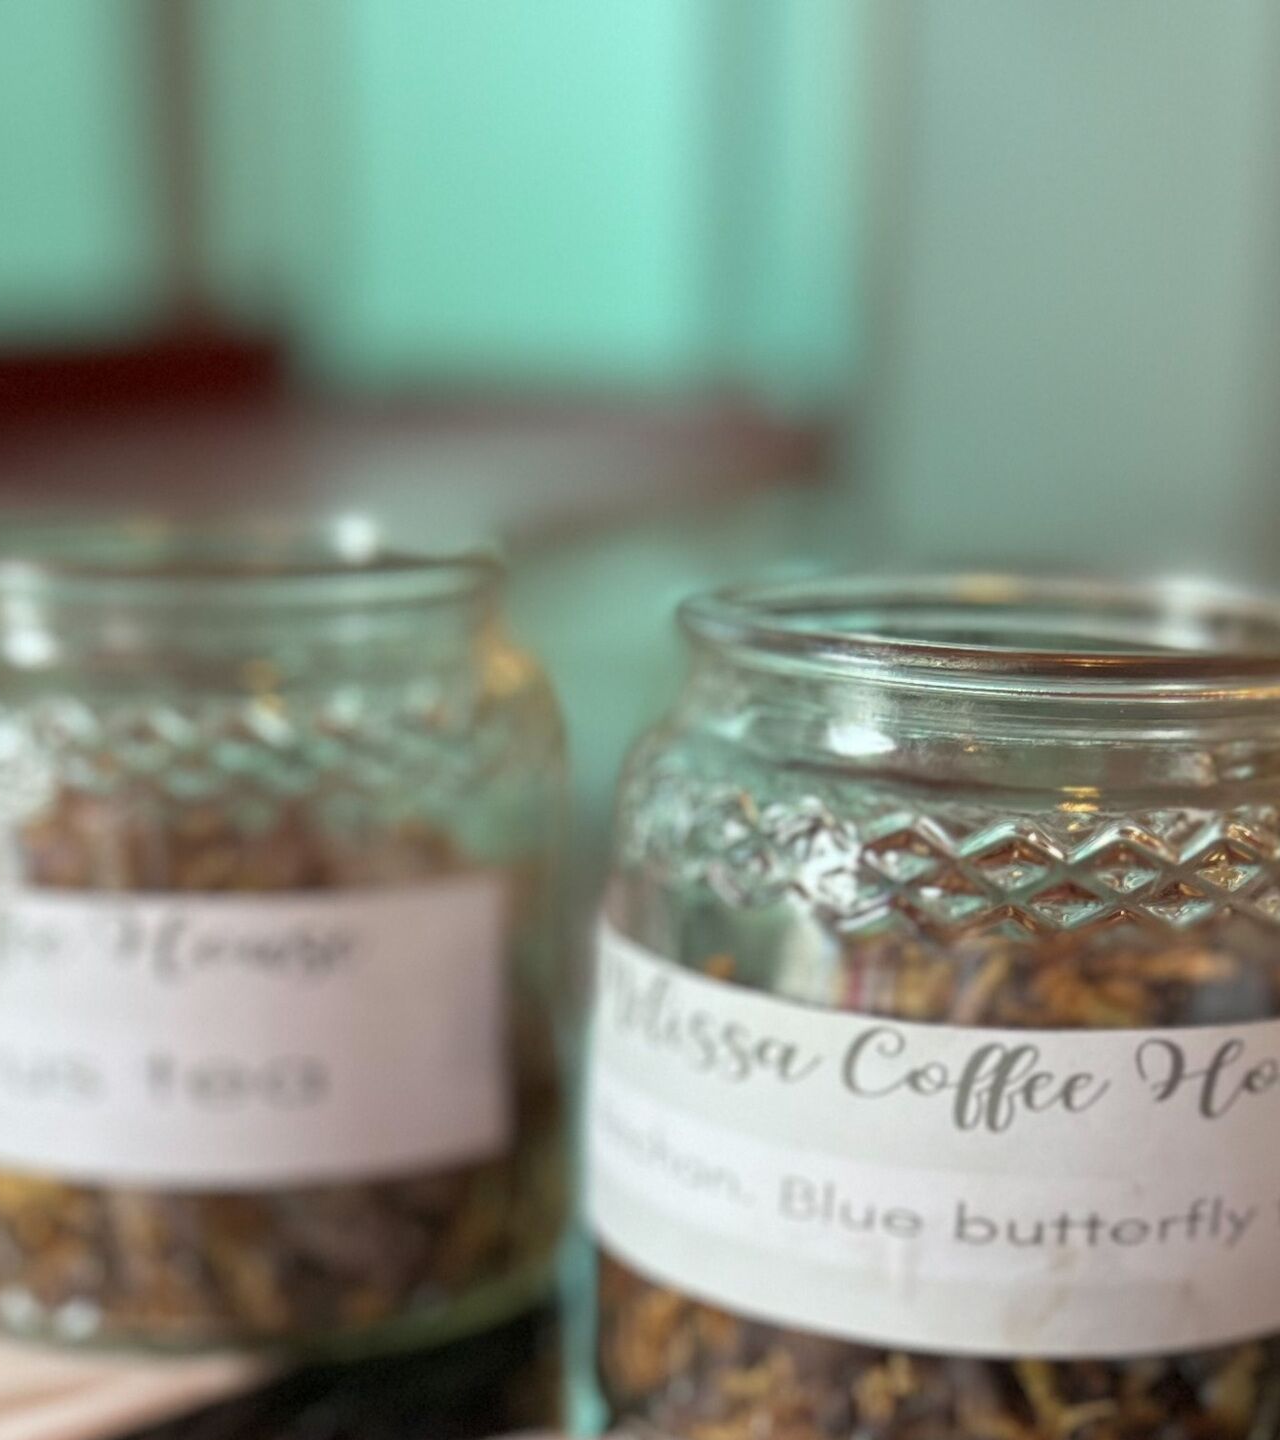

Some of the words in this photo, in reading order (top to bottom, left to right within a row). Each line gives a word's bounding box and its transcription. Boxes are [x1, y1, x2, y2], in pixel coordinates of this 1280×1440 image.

[840, 1026, 1114, 1134] Coffee
[779, 1175, 922, 1240] Blue
[955, 1195, 1259, 1250] butterfly
